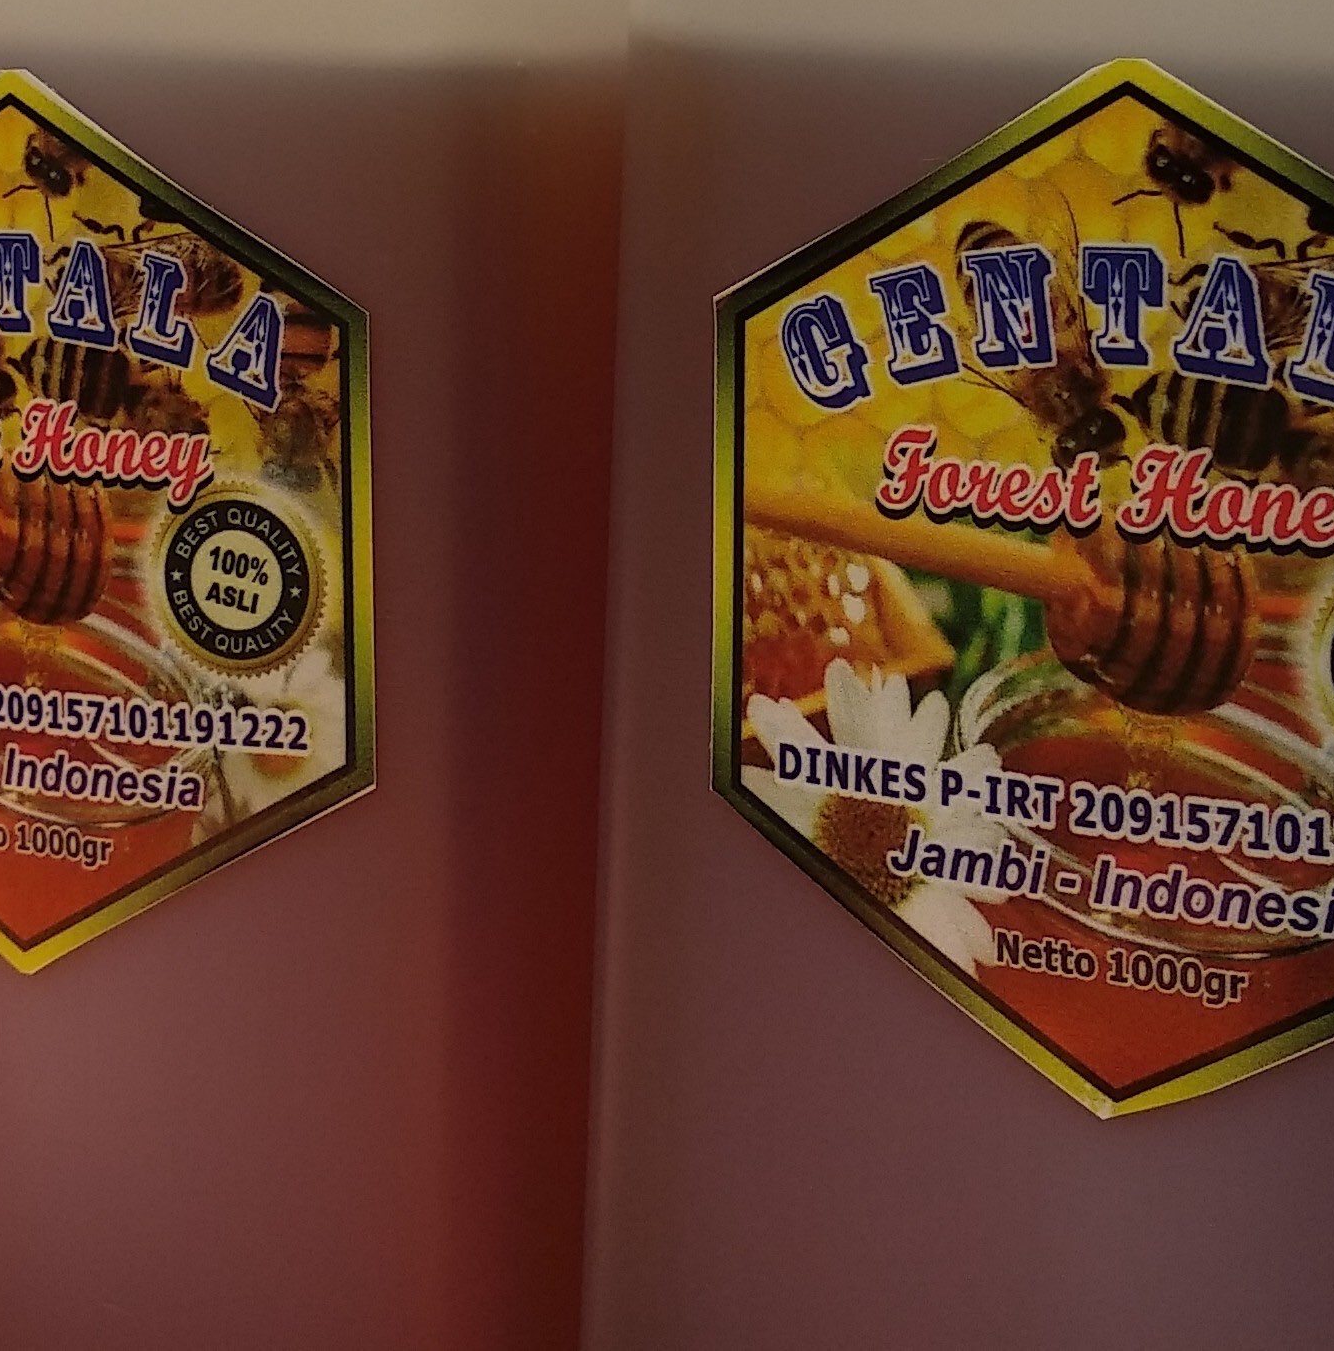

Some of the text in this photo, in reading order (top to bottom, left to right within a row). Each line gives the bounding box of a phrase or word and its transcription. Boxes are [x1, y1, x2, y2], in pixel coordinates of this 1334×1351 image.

[17, 400, 213, 512] Honey
[878, 428, 1100, 532] Forest
[175, 508, 302, 576] BEST QUALITY
[209, 545, 269, 586] 100%
[173, 589, 294, 654] BEST QUALITY
[205, 582, 260, 614] ASLI
[5, 747, 203, 808] Indonesia
[778, 741, 927, 804] DINKES
[941, 768, 1063, 825] P-IRT
[16, 825, 113, 867] 1000gr
[889, 828, 1046, 896] Jambi
[996, 930, 1248, 1006] Netto 1000gr
